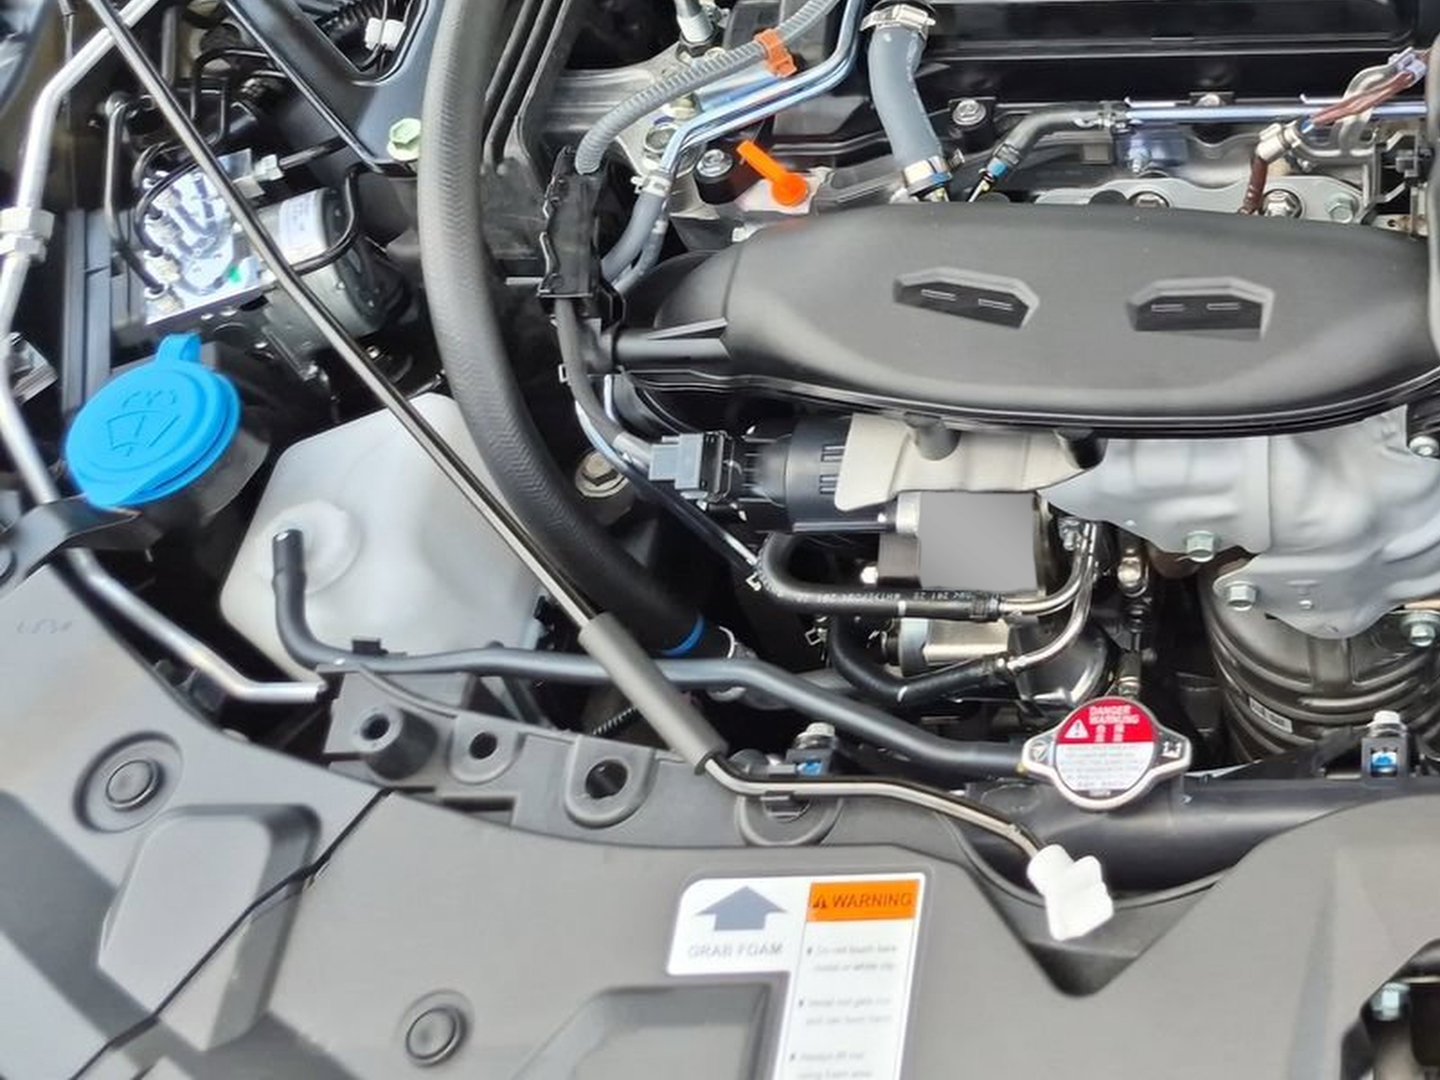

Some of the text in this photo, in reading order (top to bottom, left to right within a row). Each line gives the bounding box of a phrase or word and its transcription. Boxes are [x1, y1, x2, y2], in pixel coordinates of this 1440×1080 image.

[1089, 705, 1132, 715] DANGER
[1089, 714, 1140, 724] WARNING
[832, 891, 914, 910] WARNING
[688, 943, 784, 958] GRAB FOAM
